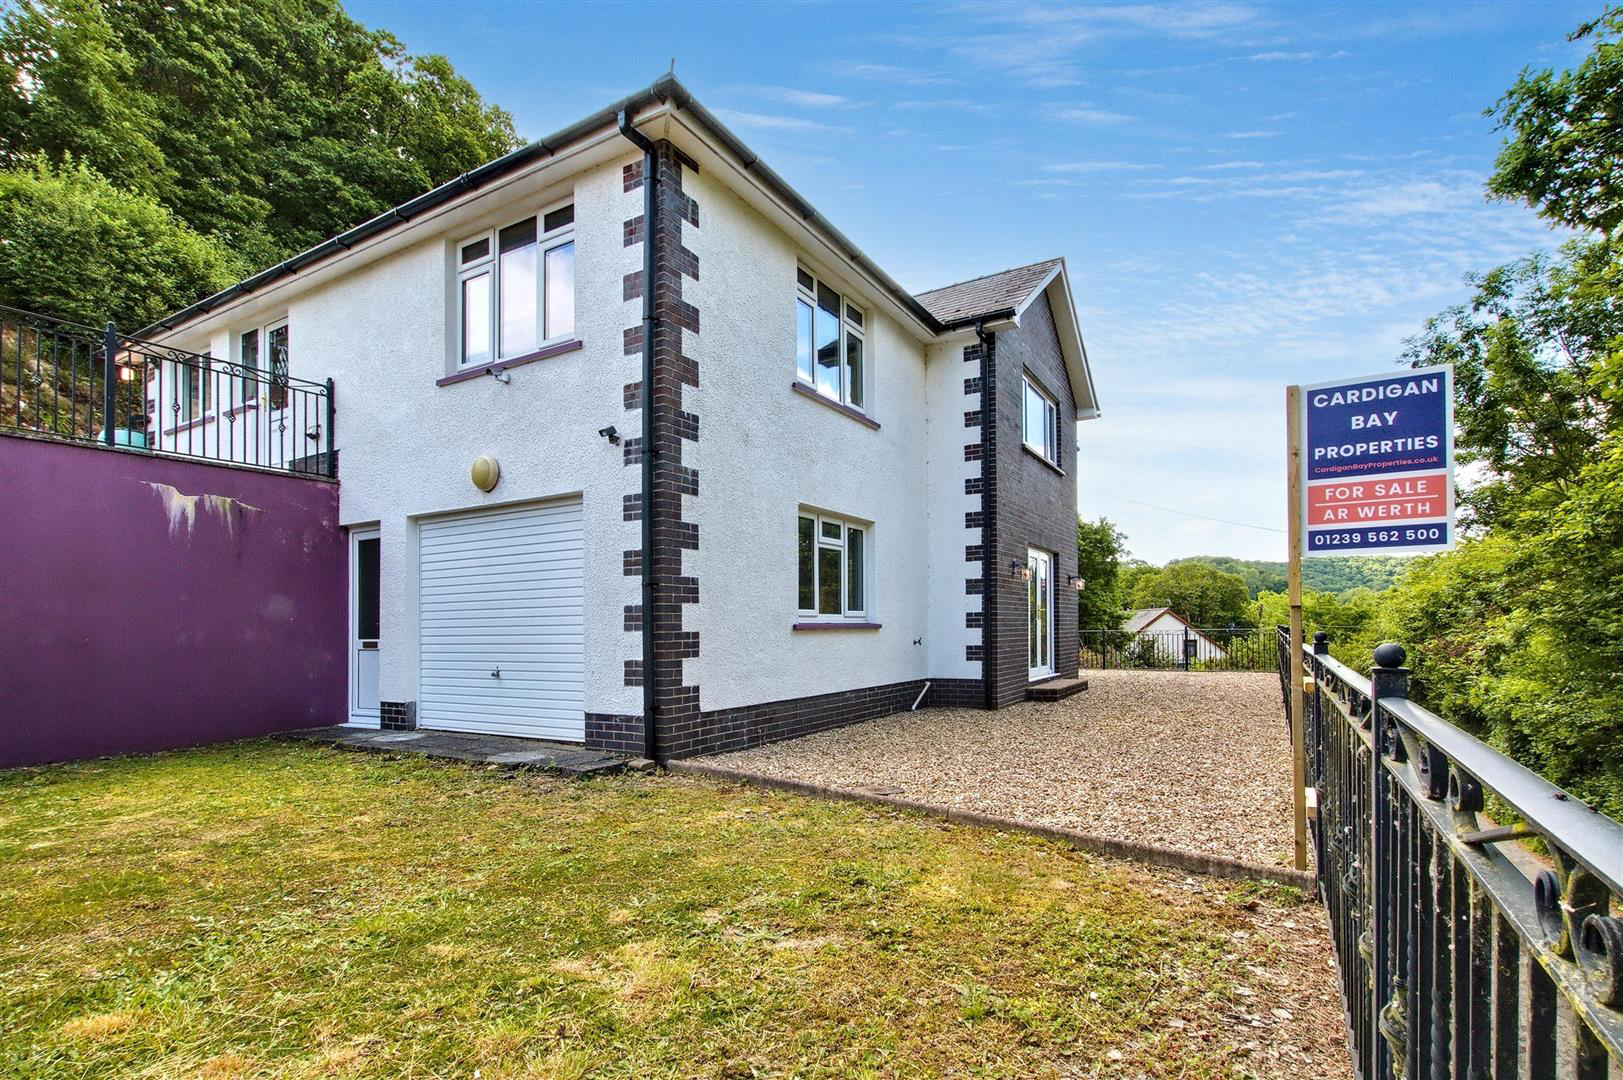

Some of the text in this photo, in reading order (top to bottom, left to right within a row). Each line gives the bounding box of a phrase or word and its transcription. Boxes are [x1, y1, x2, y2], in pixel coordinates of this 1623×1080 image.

[1313, 379, 1438, 408] CARDIGAN
[1351, 411, 1398, 430] BAY
[1314, 435, 1439, 460] PROPERTIES
[1314, 456, 1439, 474] CardiganBayProperties.co.uk
[1325, 480, 1427, 501] FOR SALE
[1323, 502, 1430, 520] AR WERTH
[1314, 528, 1439, 545] 01239 562 500
